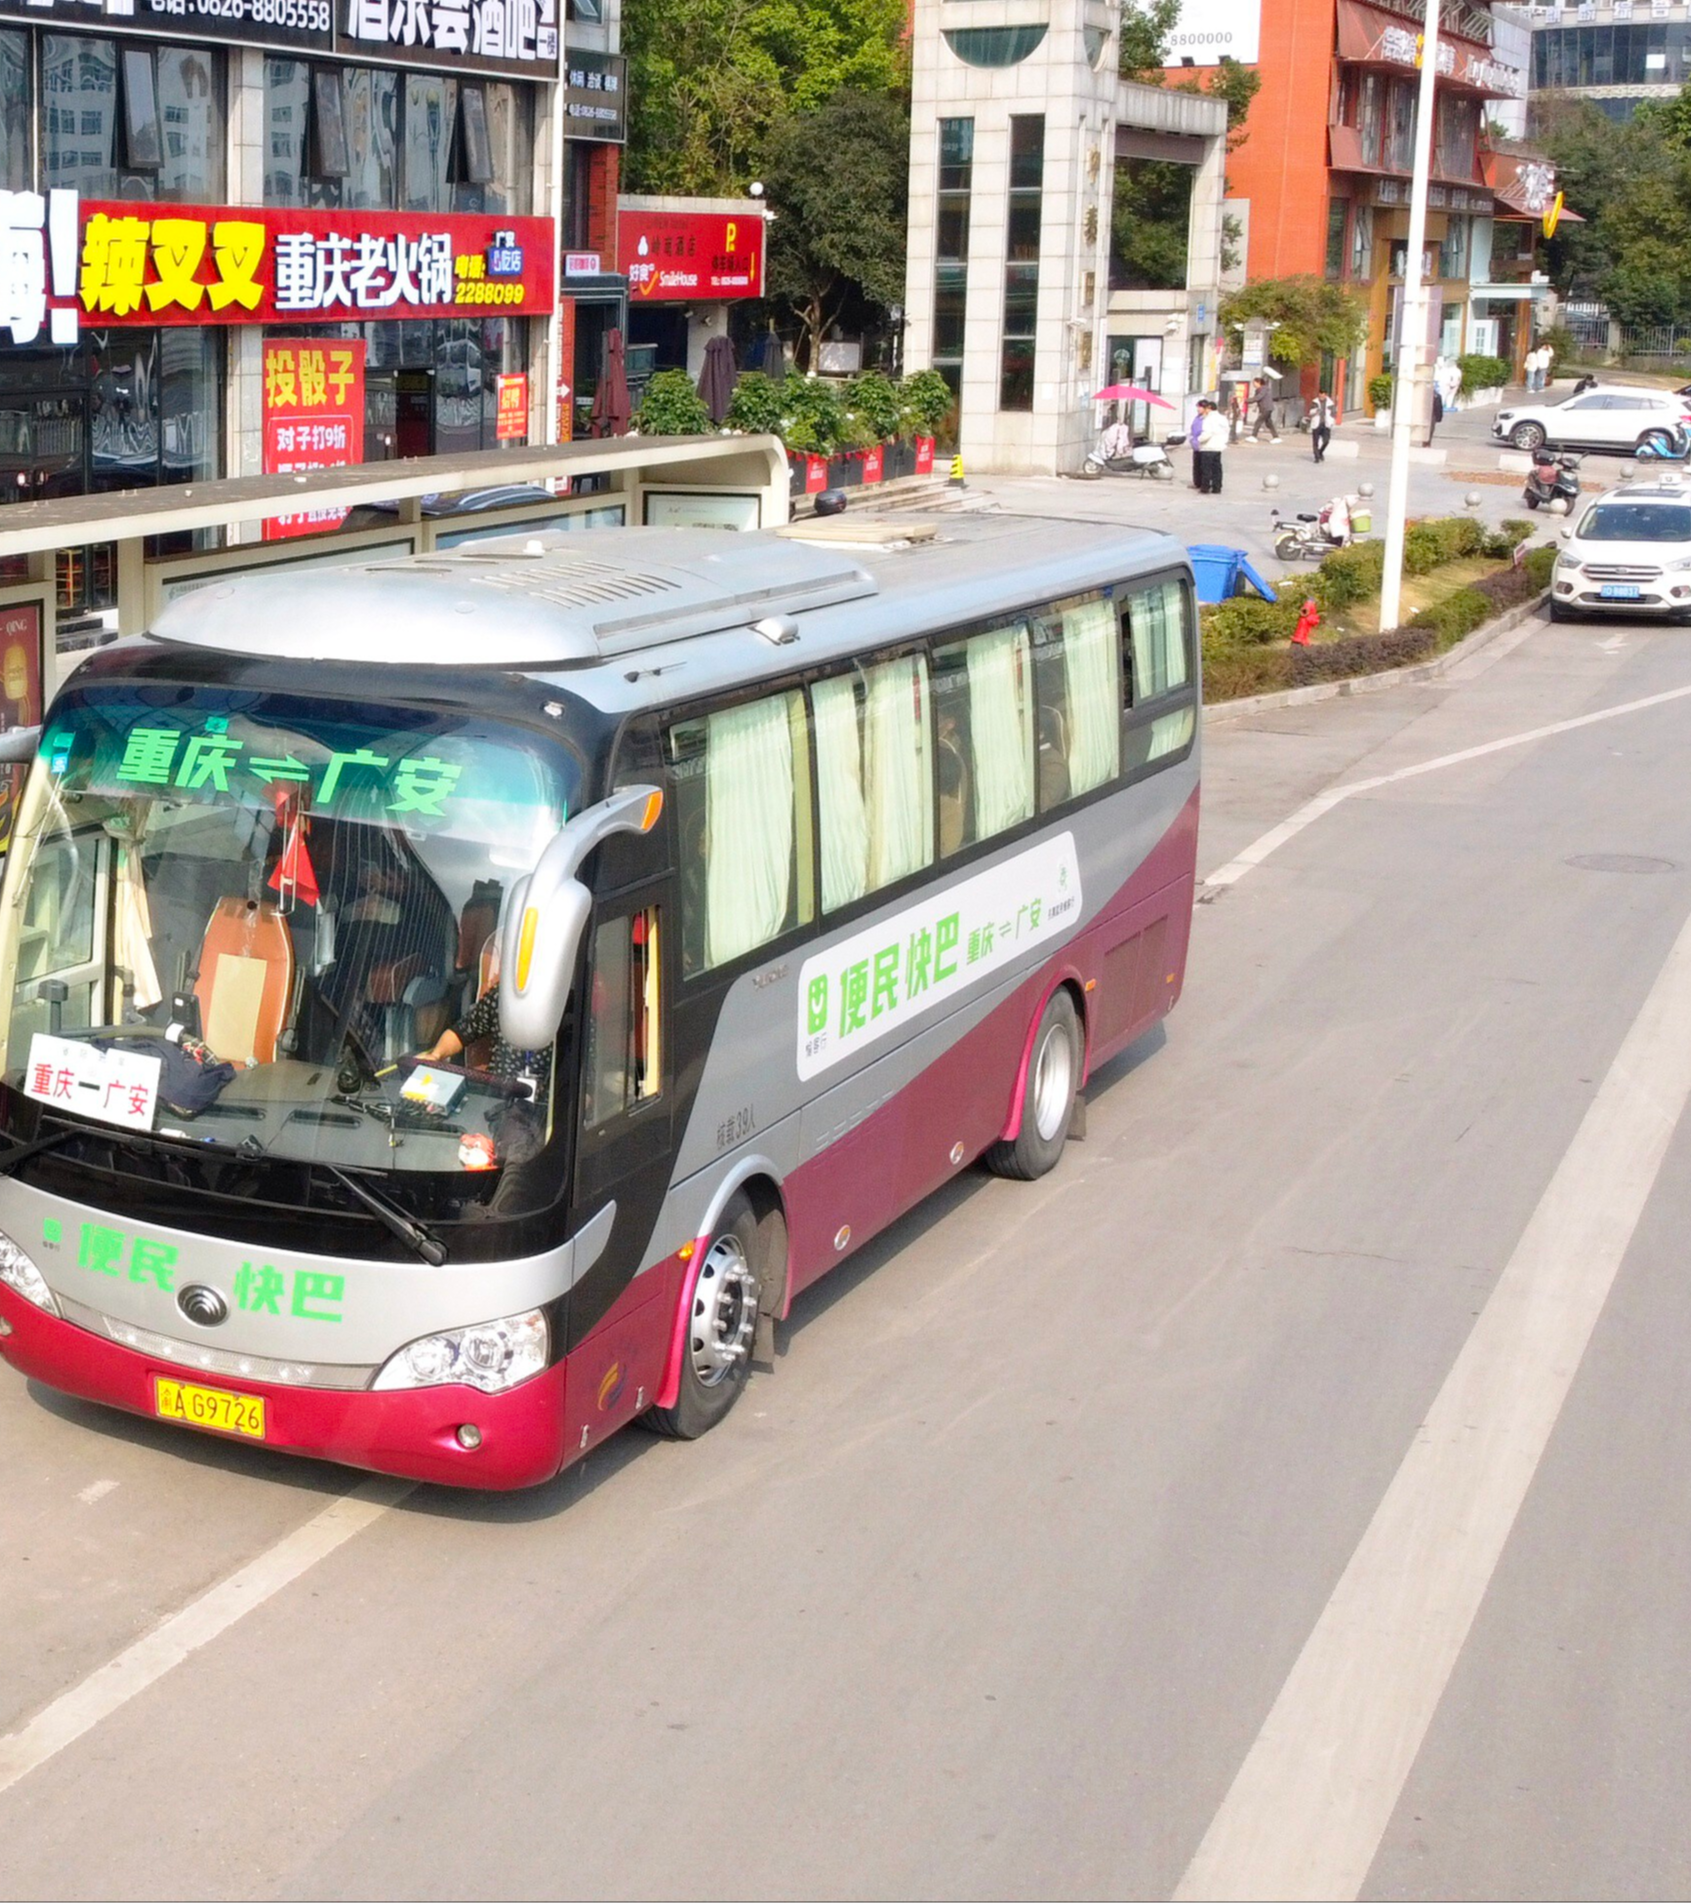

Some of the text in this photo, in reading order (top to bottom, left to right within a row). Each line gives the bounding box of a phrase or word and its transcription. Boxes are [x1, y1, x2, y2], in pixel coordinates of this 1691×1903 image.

[275, 230, 452, 311] 重庆老火锅
[455, 283, 526, 306] 2288099
[265, 348, 355, 408] 投骰子
[276, 424, 347, 452] 对子打9折
[116, 727, 464, 817] 重庆 广安
[839, 911, 960, 1038] 便民快巴
[966, 921, 995, 966] 重庆
[1015, 898, 1041, 940] 广安
[77, 1222, 346, 1323] 便民 快巴
